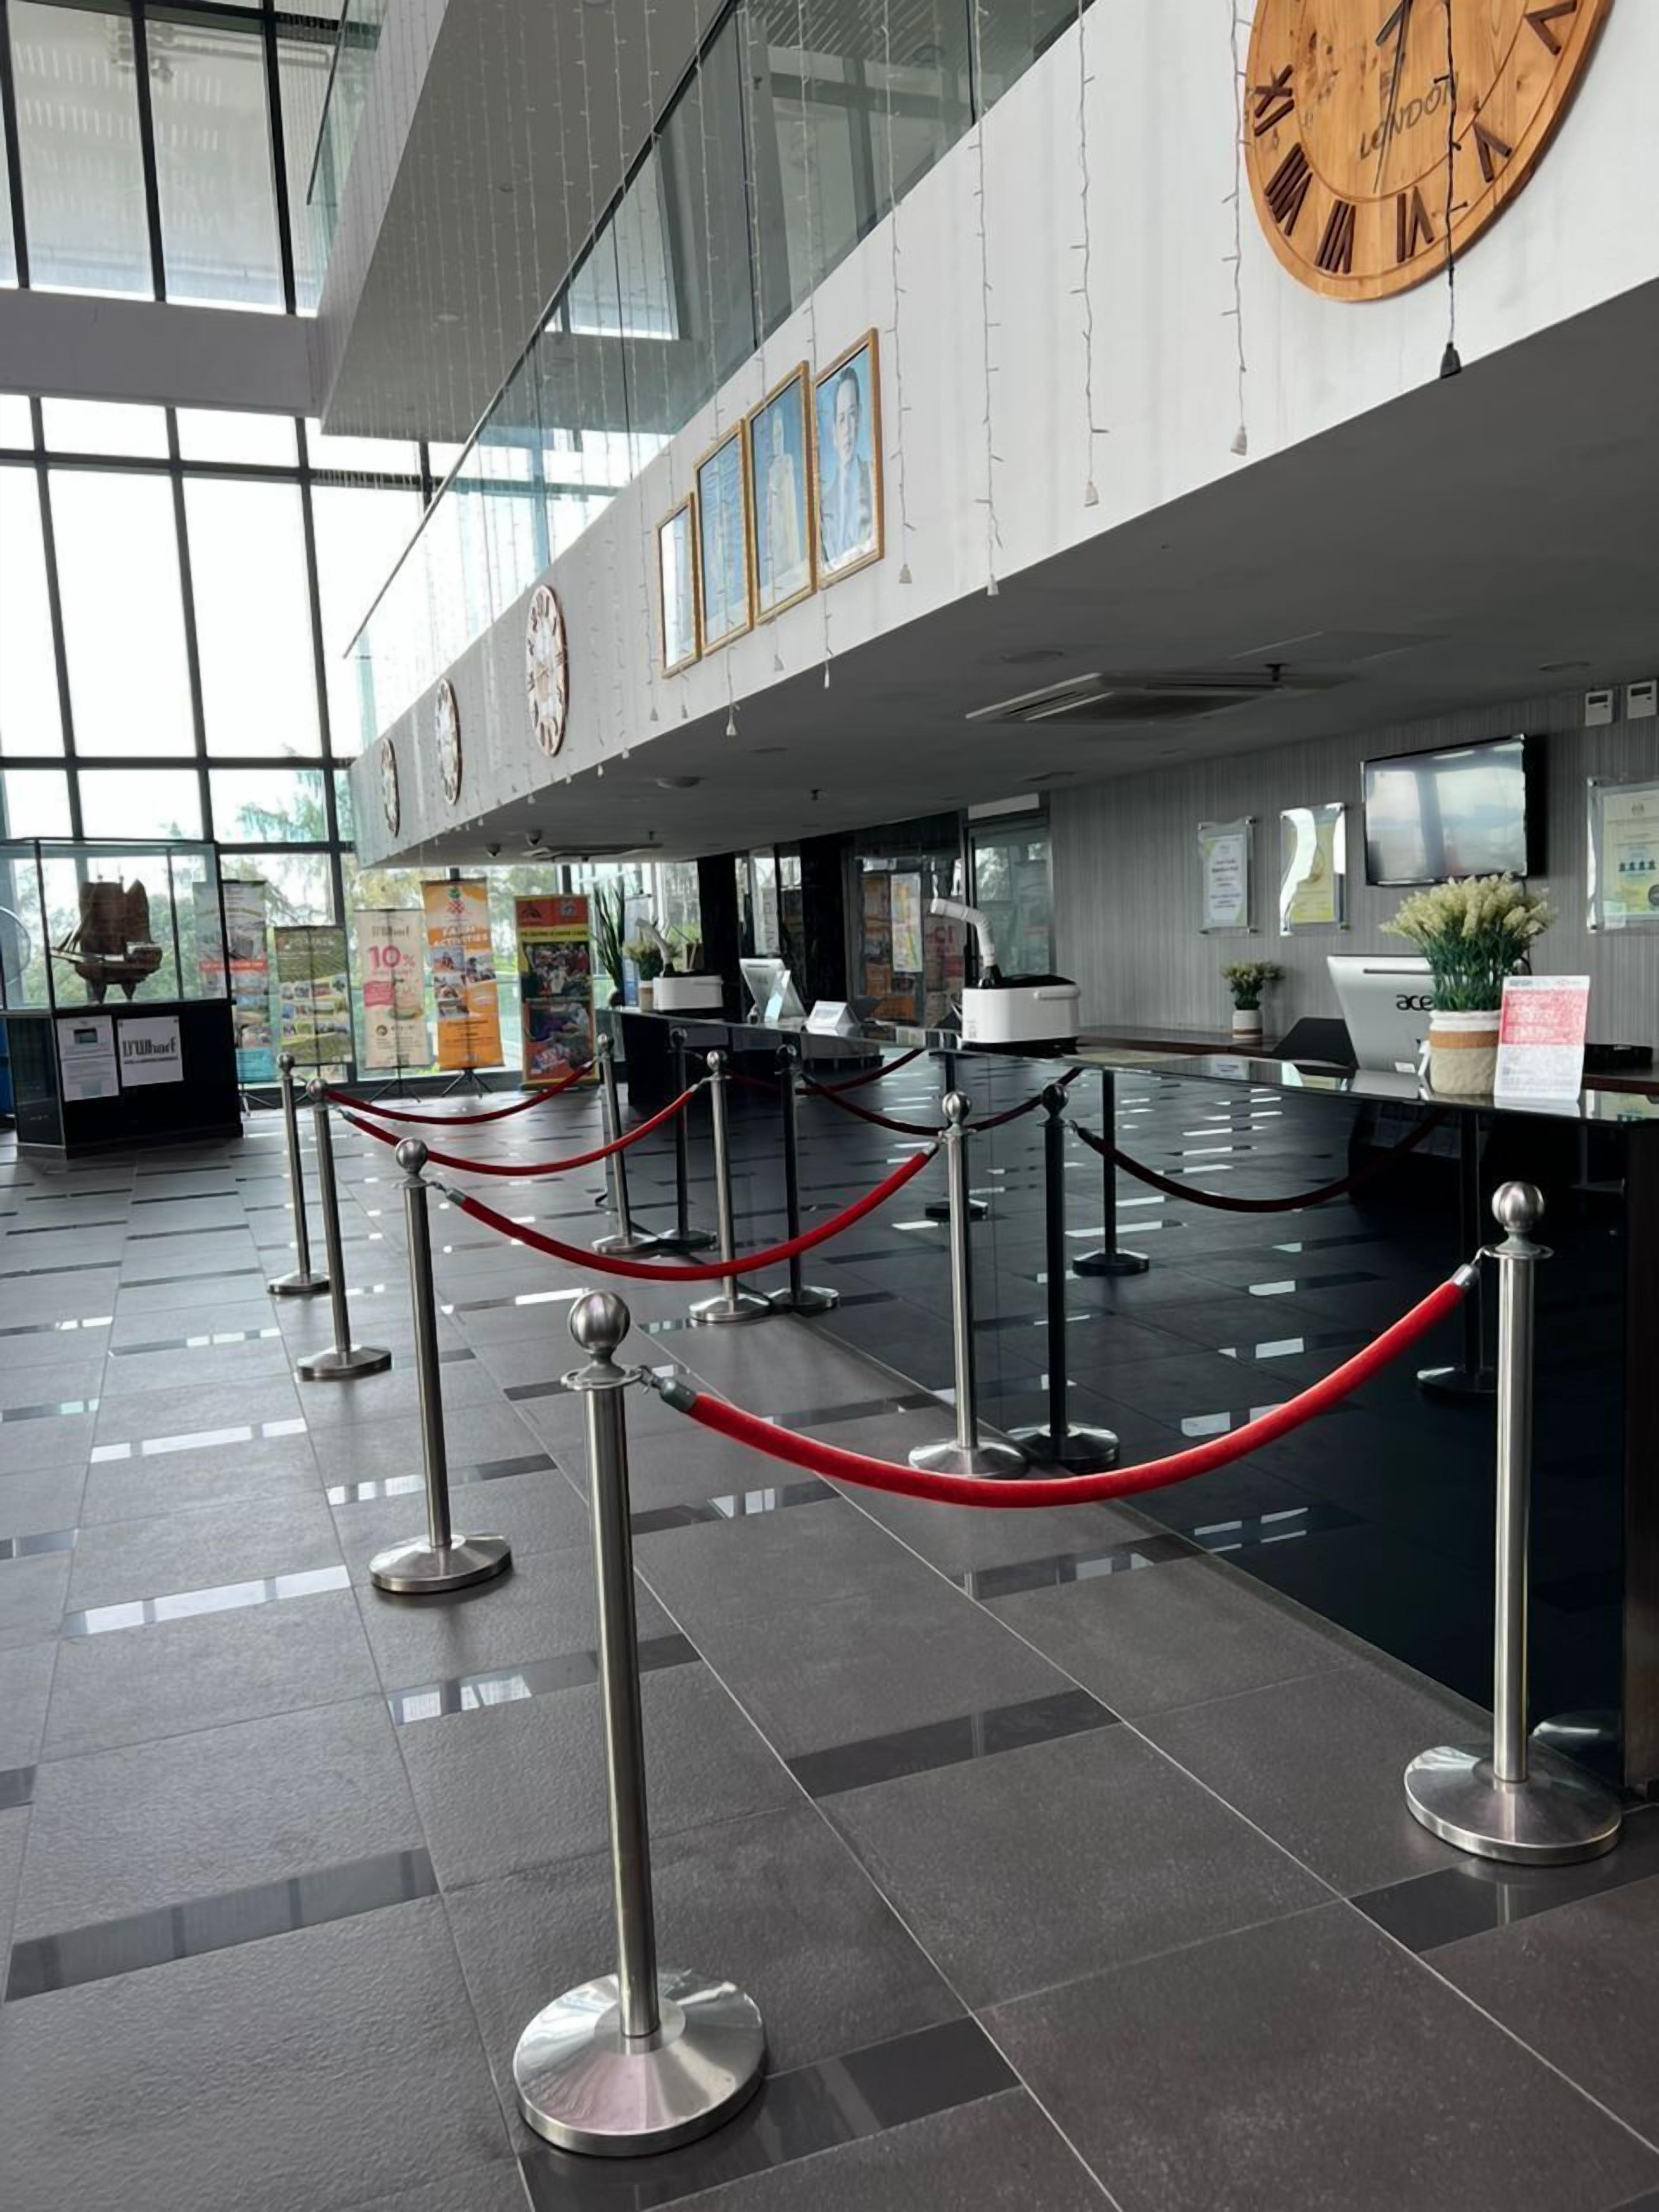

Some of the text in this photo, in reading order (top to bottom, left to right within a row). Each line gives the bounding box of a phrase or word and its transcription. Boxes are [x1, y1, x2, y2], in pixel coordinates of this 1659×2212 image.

[1254, 64, 1294, 137] IX
[1264, 142, 1313, 237] VIII
[1473, 123, 1512, 183] V
[1313, 199, 1355, 274] VII
[1396, 186, 1434, 263] VI
[368, 945, 416, 968] 10%
[1396, 994, 1434, 1011] ace
